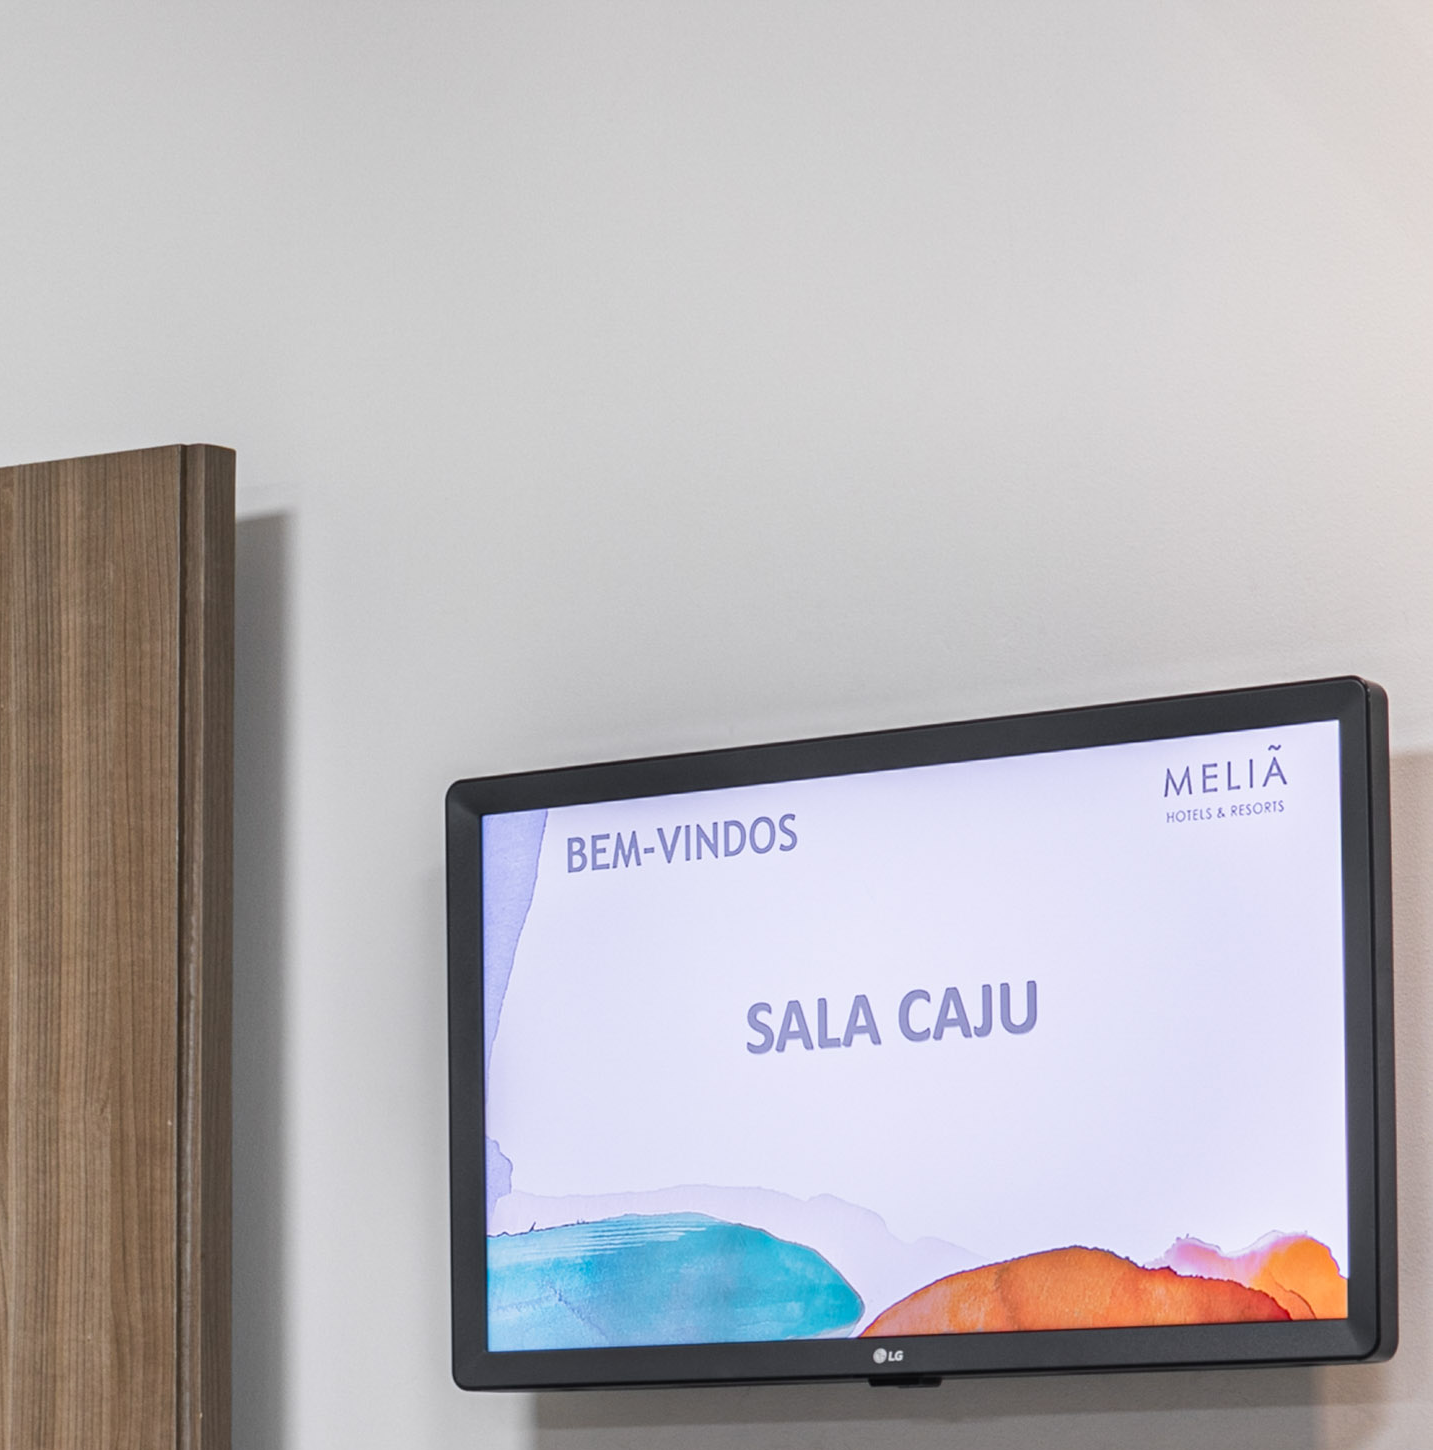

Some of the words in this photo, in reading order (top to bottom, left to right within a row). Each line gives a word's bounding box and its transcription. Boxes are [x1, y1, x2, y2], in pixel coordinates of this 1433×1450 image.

[1163, 744, 1288, 798] MELIÃ
[1166, 807, 1212, 823] HOTELS
[1216, 807, 1226, 819] &
[1230, 799, 1285, 817] RESORTS
[567, 813, 798, 873] BEM-VINDOS
[746, 994, 882, 1055] SALA
[898, 980, 1038, 1042] CAJU
[887, 1350, 904, 1362] LG
